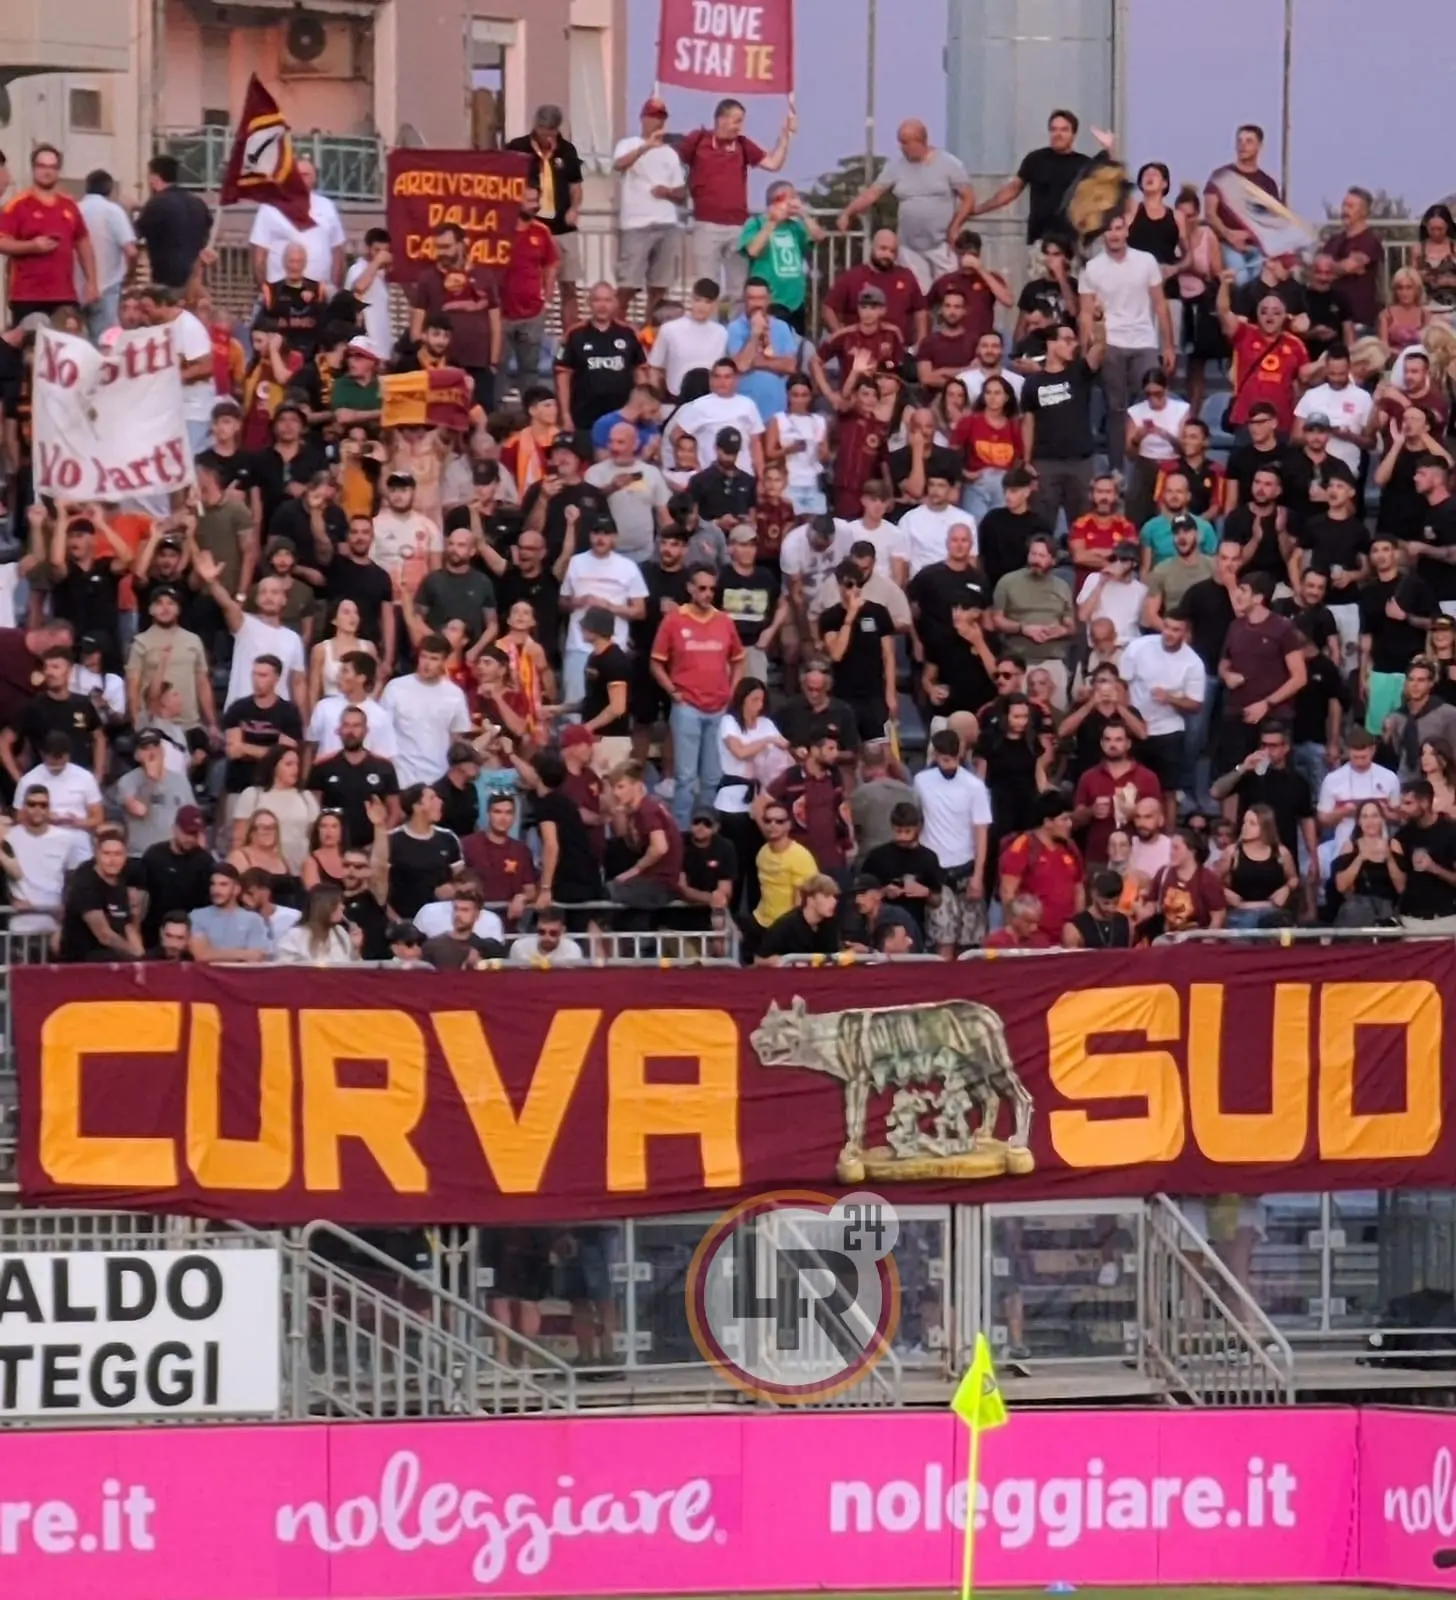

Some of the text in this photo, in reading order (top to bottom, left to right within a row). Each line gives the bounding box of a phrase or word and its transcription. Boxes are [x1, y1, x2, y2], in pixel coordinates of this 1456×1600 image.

[692, 1, 764, 41] DOVE
[674, 36, 774, 80] STAI TE
[406, 234, 511, 265] CAALE
[428, 203, 497, 231] DALLA
[40, 980, 1442, 1193] CURVA SUD
[0, 1254, 224, 1323] ALDO
[0, 1340, 220, 1409] TEGGI
[0, 1481, 156, 1555] re.it
[276, 1450, 715, 1583] noleggiare
[830, 1456, 1297, 1549] noleggiare.it
[1384, 1446, 1456, 1537] nol
